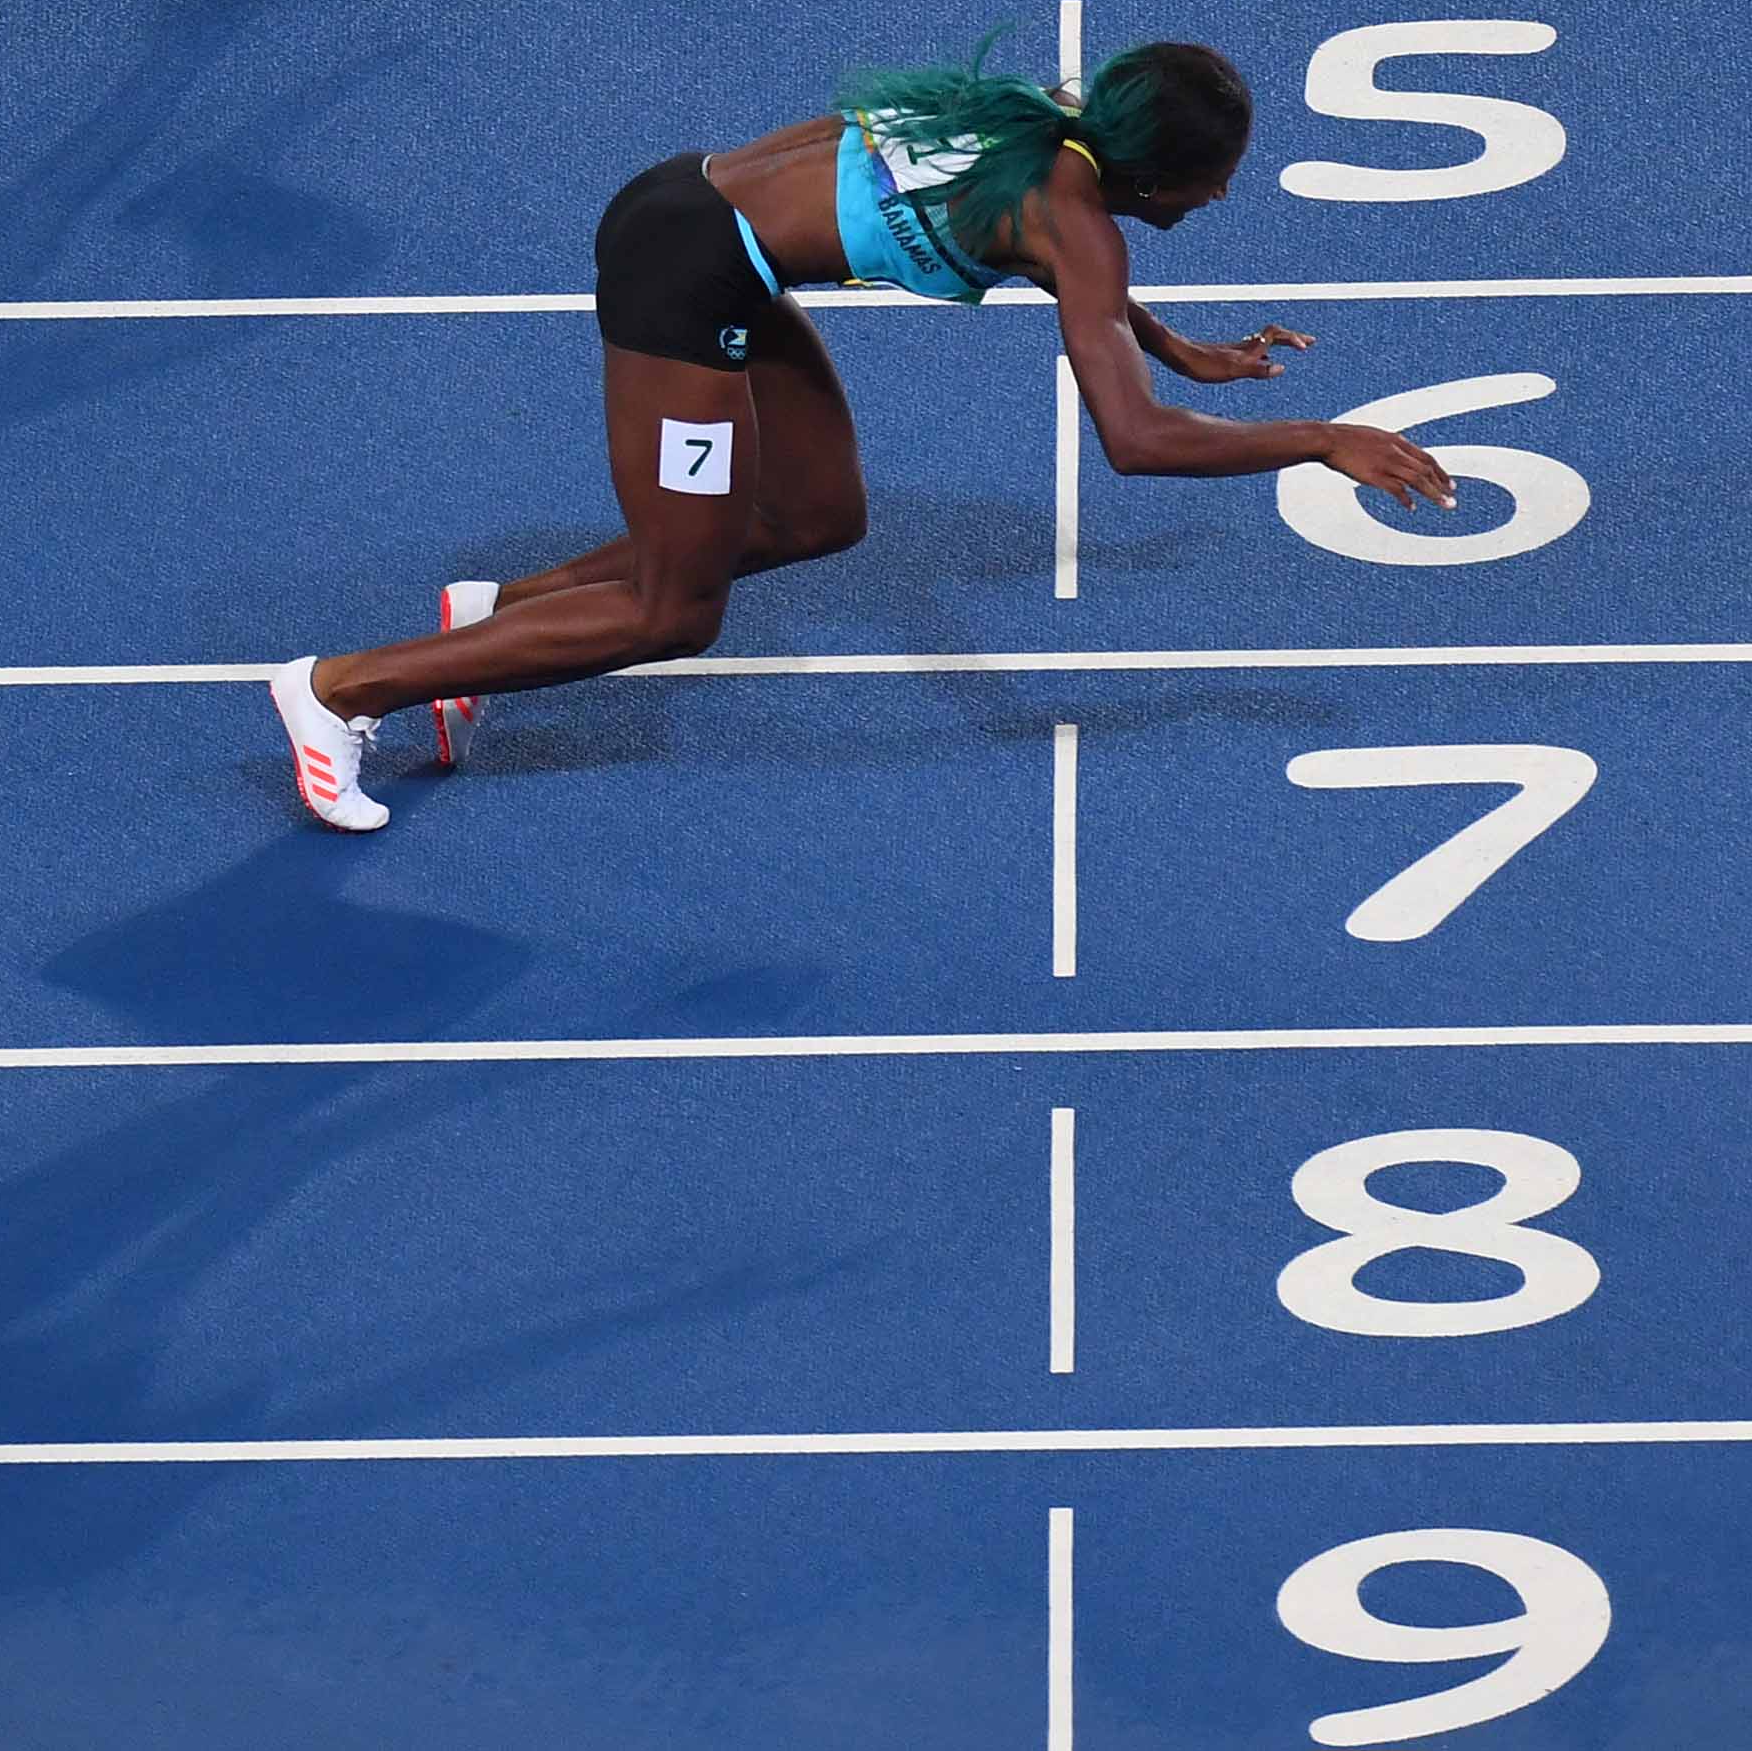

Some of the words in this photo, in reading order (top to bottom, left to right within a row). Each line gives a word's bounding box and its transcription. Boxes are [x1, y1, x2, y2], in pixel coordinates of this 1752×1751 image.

[1279, 19, 1567, 202] 5
[878, 195, 942, 275] BAHAMAS
[685, 438, 713, 477] 7
[1277, 372, 1591, 566] 6
[1286, 744, 1598, 942] 7
[1277, 1129, 1601, 1337] 8
[1277, 1529, 1612, 1746] 9
